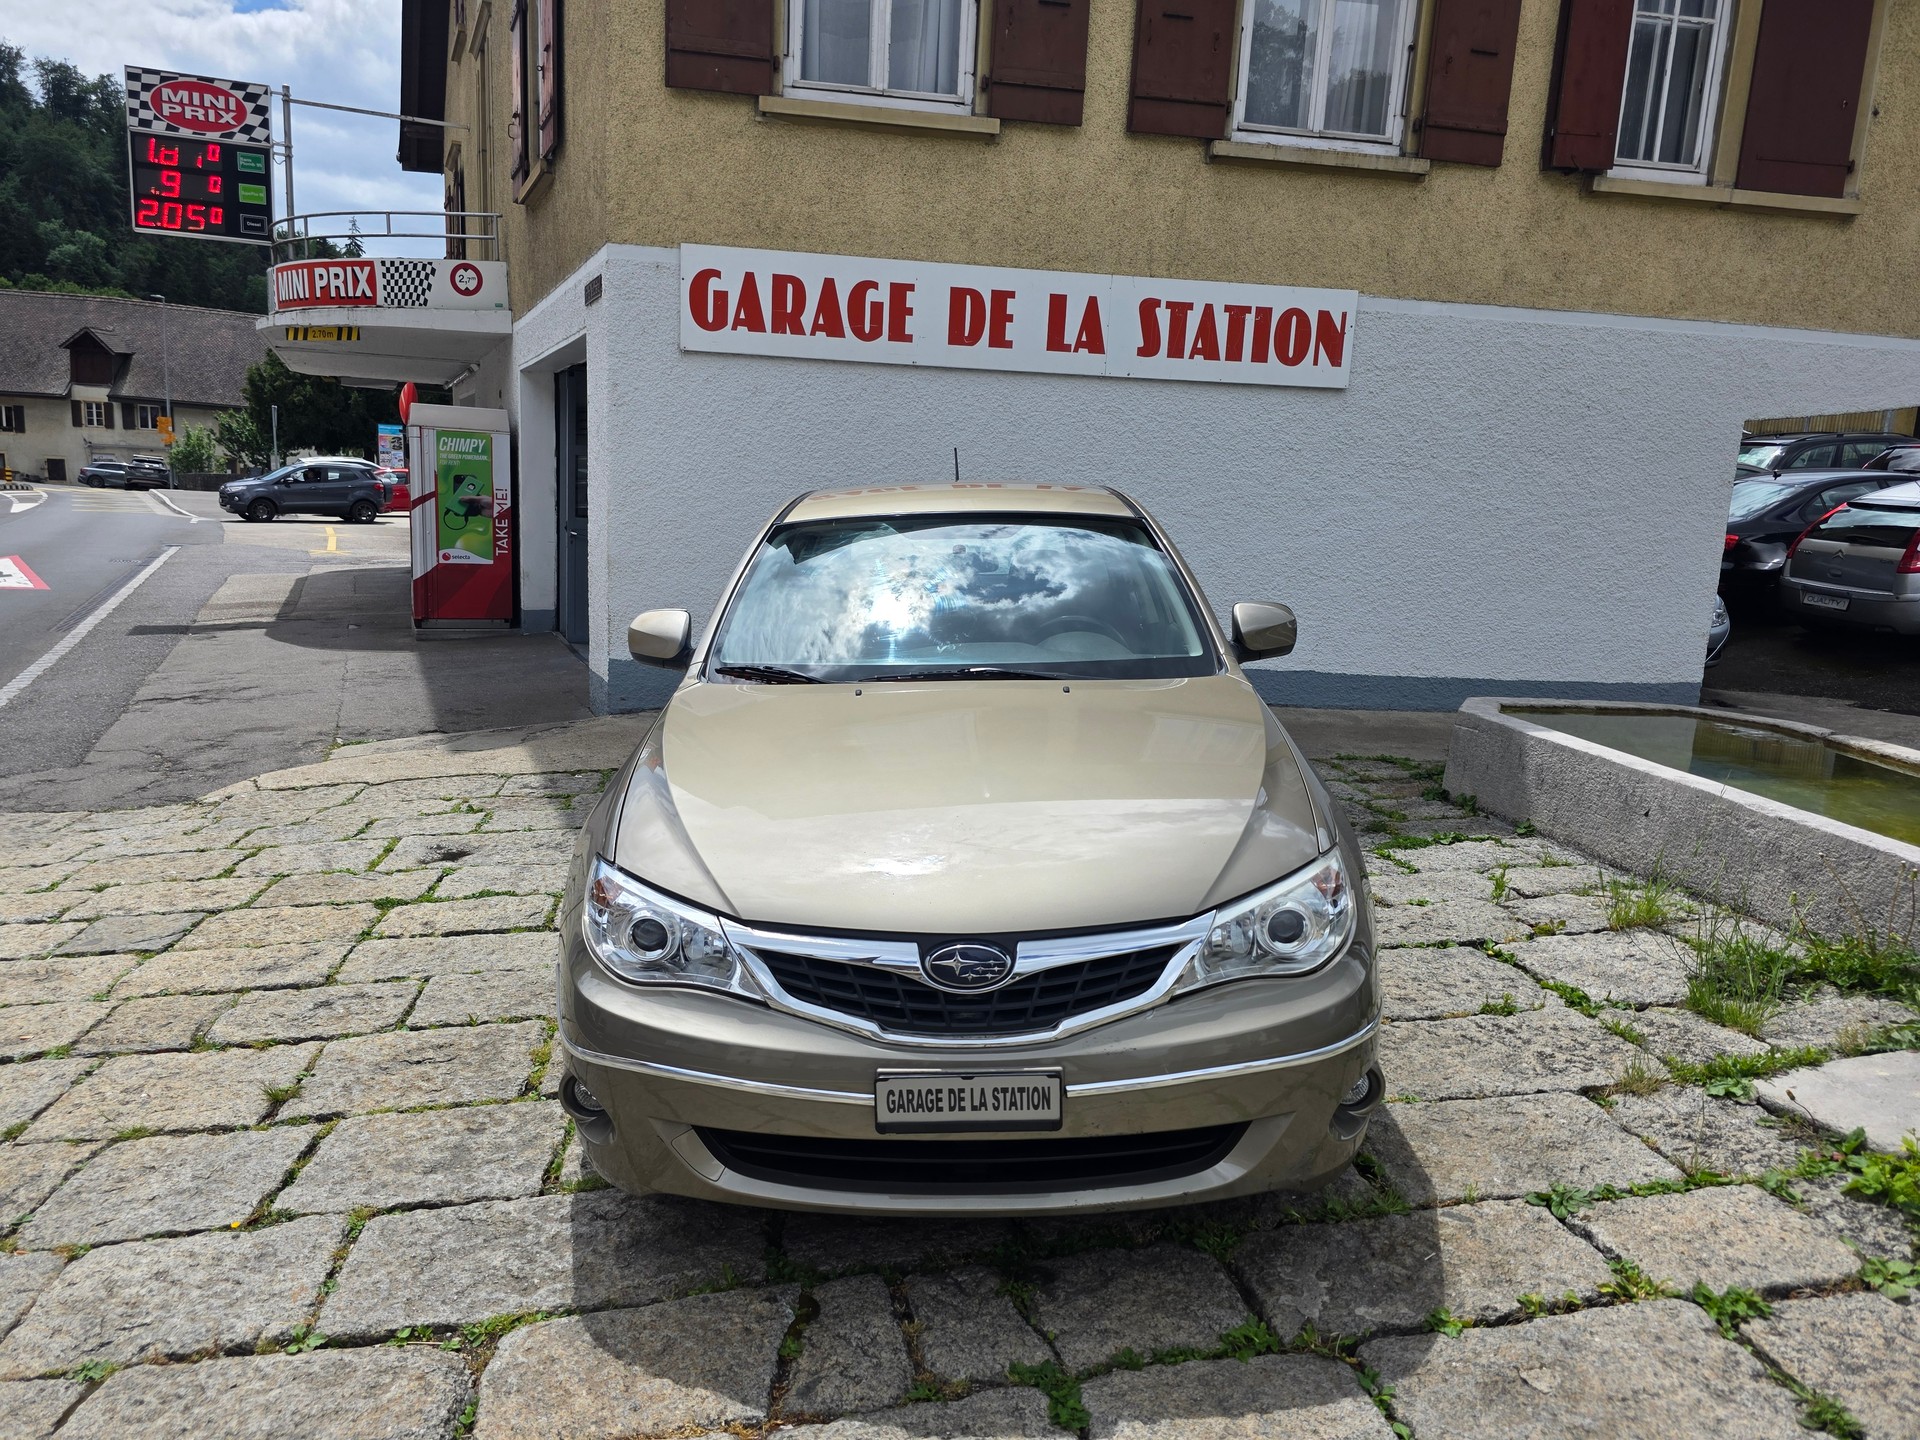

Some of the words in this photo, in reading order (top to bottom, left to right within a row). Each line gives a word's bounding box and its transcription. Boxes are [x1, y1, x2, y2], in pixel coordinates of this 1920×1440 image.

[161, 87, 237, 111] MINI
[161, 103, 238, 125] PRIX
[278, 268, 309, 302] MINI
[314, 266, 374, 299] PRIX
[688, 268, 916, 343] GARAGE
[947, 286, 1016, 349] DE
[1045, 293, 1106, 355] LA
[1136, 297, 1348, 368] STATION
[312, 329, 334, 339] 2.70m
[439, 437, 486, 453] CHIMPY
[495, 488, 508, 516] ME!
[495, 519, 508, 557] TAKE
[886, 1088, 944, 1114] GARAGE
[948, 1088, 966, 1112] DE
[970, 1087, 988, 1111] LA
[992, 1086, 1051, 1111] STATION
